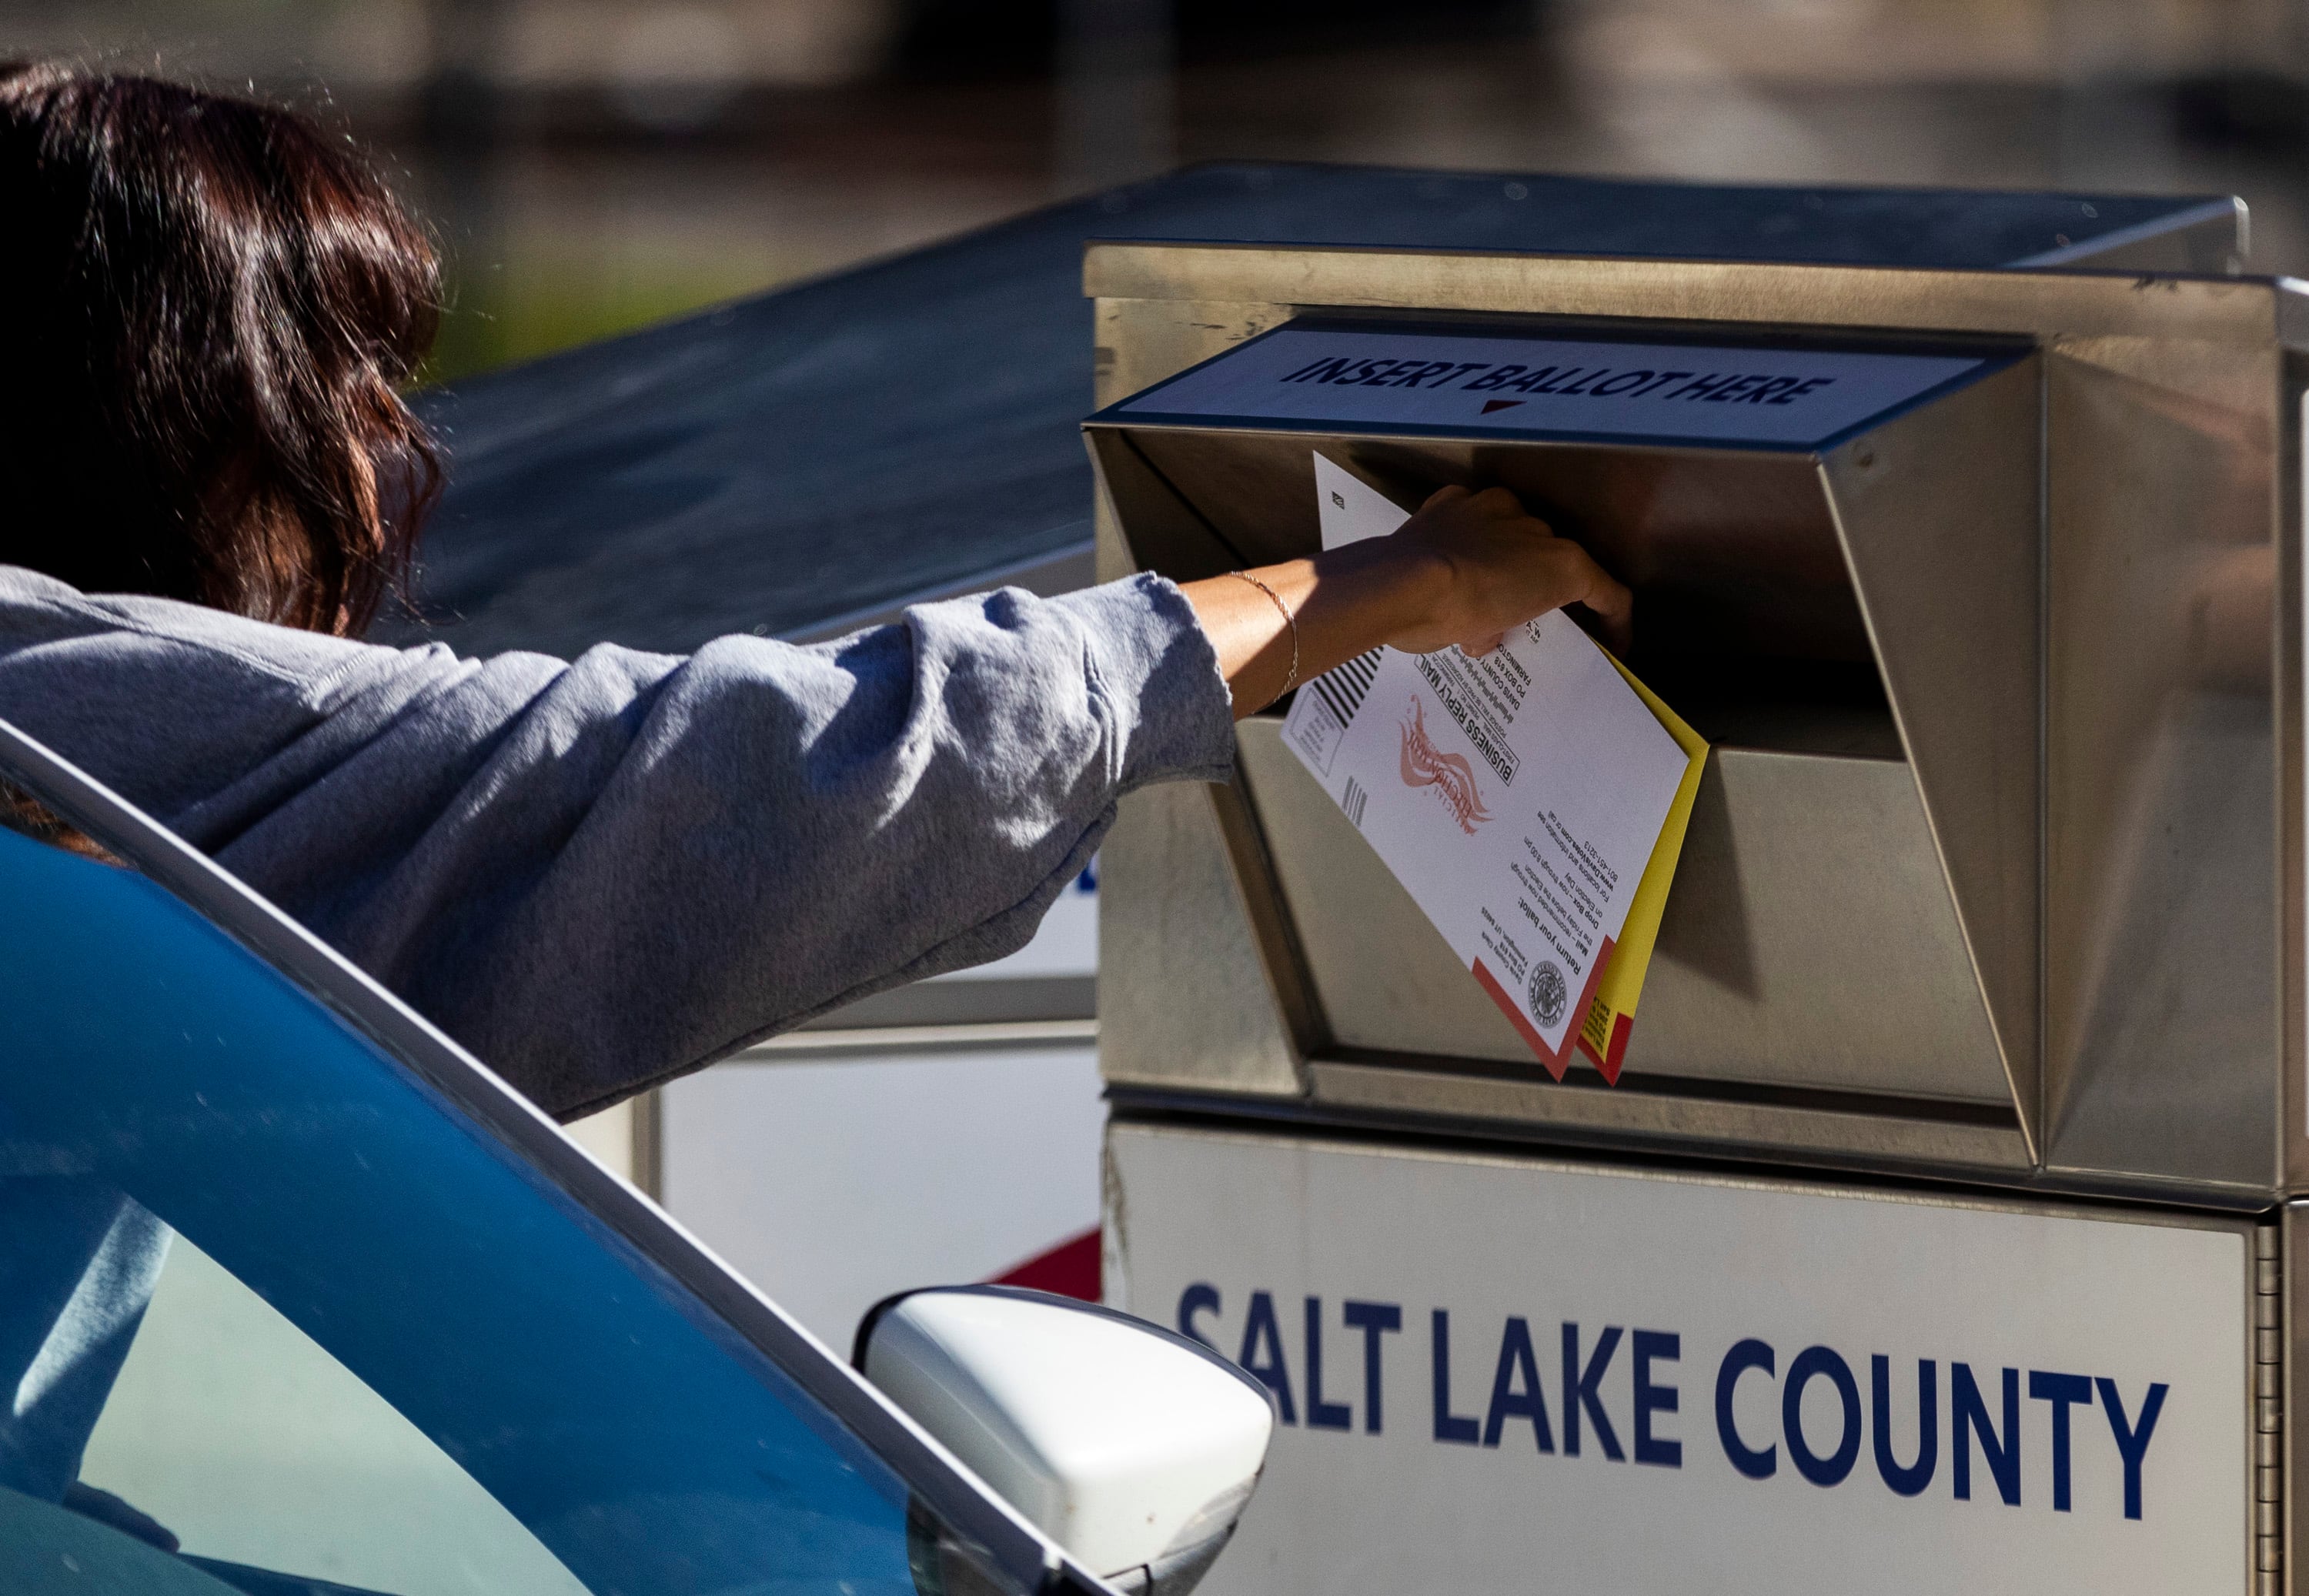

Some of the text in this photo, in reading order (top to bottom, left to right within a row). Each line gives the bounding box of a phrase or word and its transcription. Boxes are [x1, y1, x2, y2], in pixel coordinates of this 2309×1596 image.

[1279, 357, 1836, 405] INSERT BALLOT HERE
[1479, 659, 1520, 711] DAVIS COUNTY
[1493, 655, 1525, 698] PO BOX 618
[1420, 653, 1512, 781] BUSINESS REPLY MAIL
[1432, 759, 1472, 819] ELECTION
[1543, 820, 1569, 858] information
[1555, 819, 1562, 831] or
[1522, 834, 1532, 850] pm
[1509, 858, 1529, 888] through
[1539, 856, 1559, 885] through
[1559, 826, 1615, 893] www.DavisVotes.com
[1567, 850, 1579, 868] and
[1582, 839, 1619, 883] 801-451-3213
[1527, 882, 1539, 899] now
[1557, 878, 1569, 896] now
[1577, 862, 1600, 893] locations
[1523, 863, 1593, 947] the Friday before the Election
[1563, 870, 1603, 920] on Election Day
[1572, 896, 1585, 915] Box
[1599, 886, 1610, 903] For
[1493, 922, 1502, 936] UT
[1536, 893, 1572, 939] recommended
[1583, 907, 1599, 930] Drop
[1517, 895, 1581, 977] Return your ballot:
[1575, 938, 1589, 957] Mail
[1492, 943, 1509, 970] County
[1507, 950, 1518, 967] Box
[1516, 962, 1525, 977] PO
[1508, 964, 1522, 986] Davis
[1432, 1307, 1682, 1468] LAKE
[1714, 1337, 2170, 1521] COUNTY
